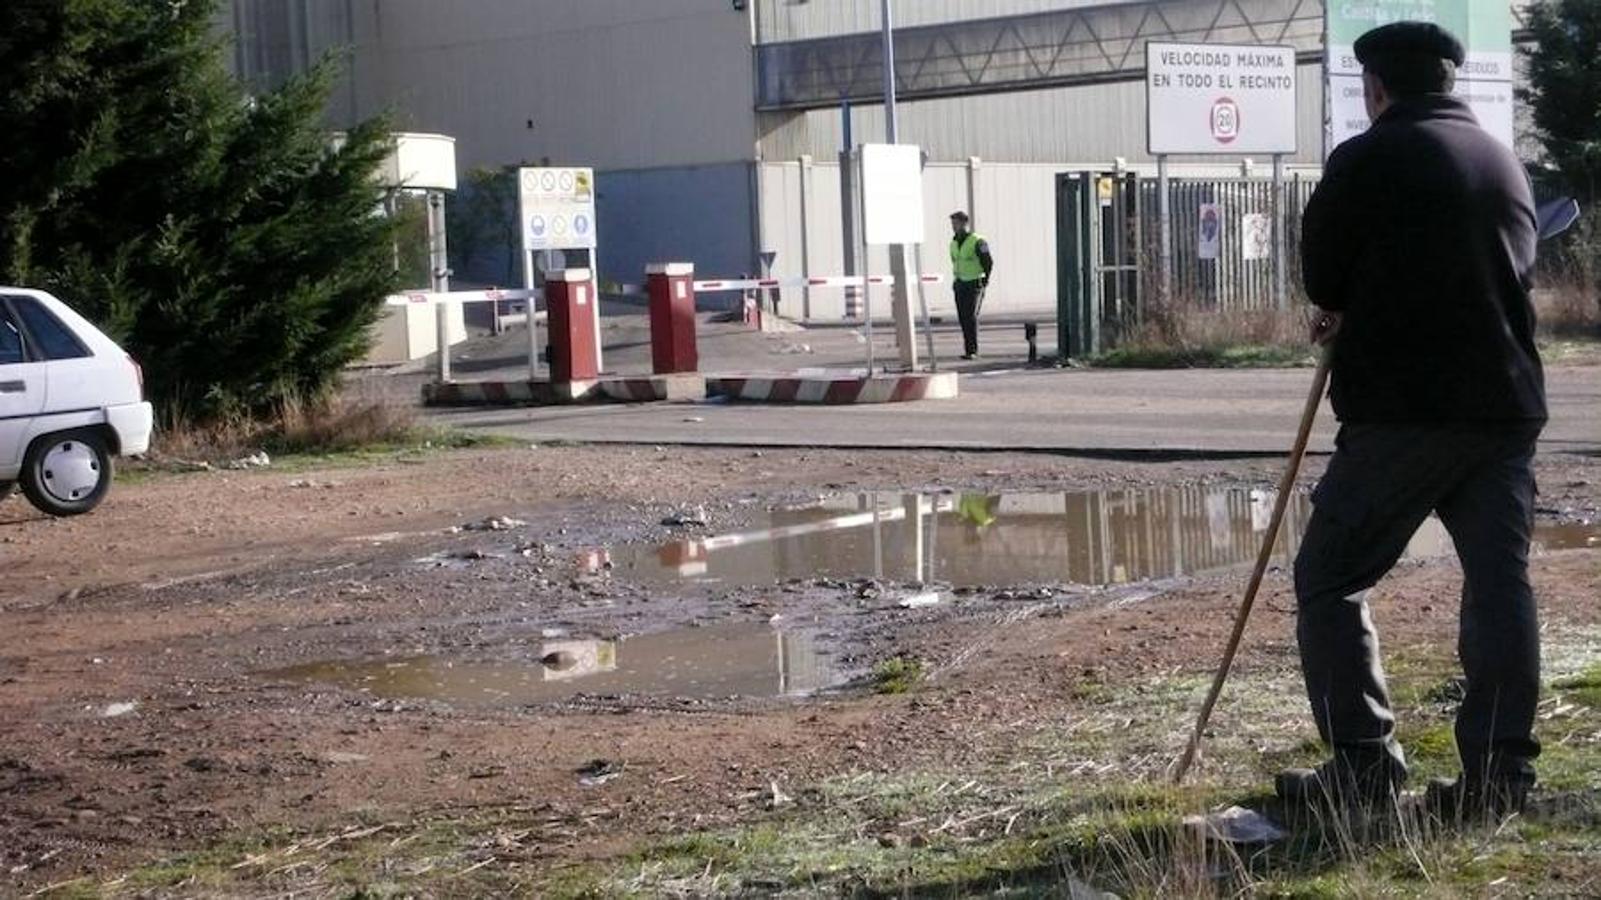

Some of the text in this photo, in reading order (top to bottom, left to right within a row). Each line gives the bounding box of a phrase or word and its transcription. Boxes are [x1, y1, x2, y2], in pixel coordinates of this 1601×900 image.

[1161, 52, 1231, 67] VELOCIDAD
[1153, 73, 1292, 89] EN TODO EL RECINTO
[1219, 114, 1232, 127] 20
